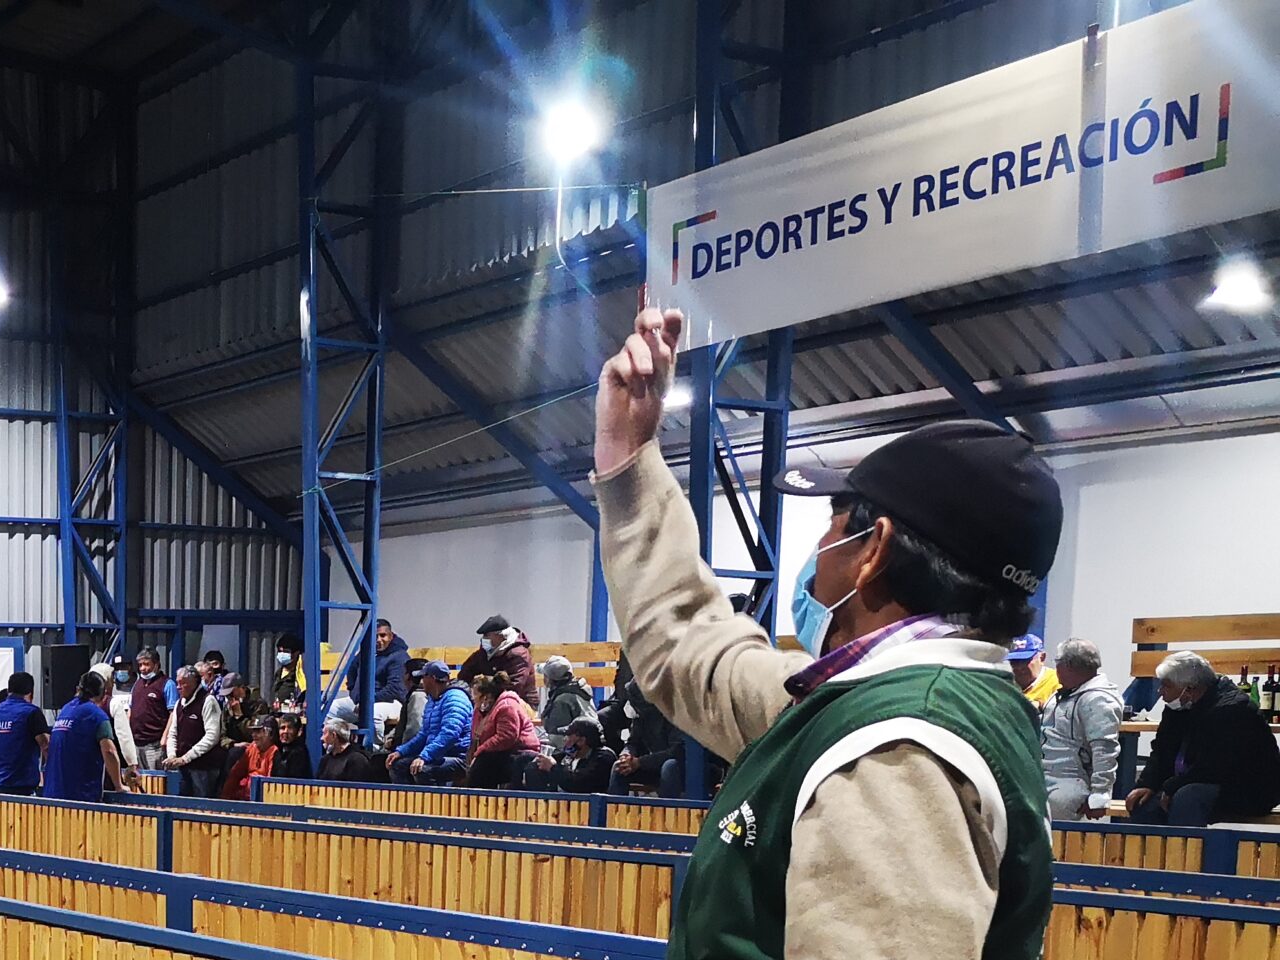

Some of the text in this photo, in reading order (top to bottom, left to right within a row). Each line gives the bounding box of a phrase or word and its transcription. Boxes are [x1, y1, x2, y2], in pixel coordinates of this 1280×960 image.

[691, 93, 1201, 281] DEPORTES Y RECREACIÓN
[1002, 564, 1040, 593] adida
